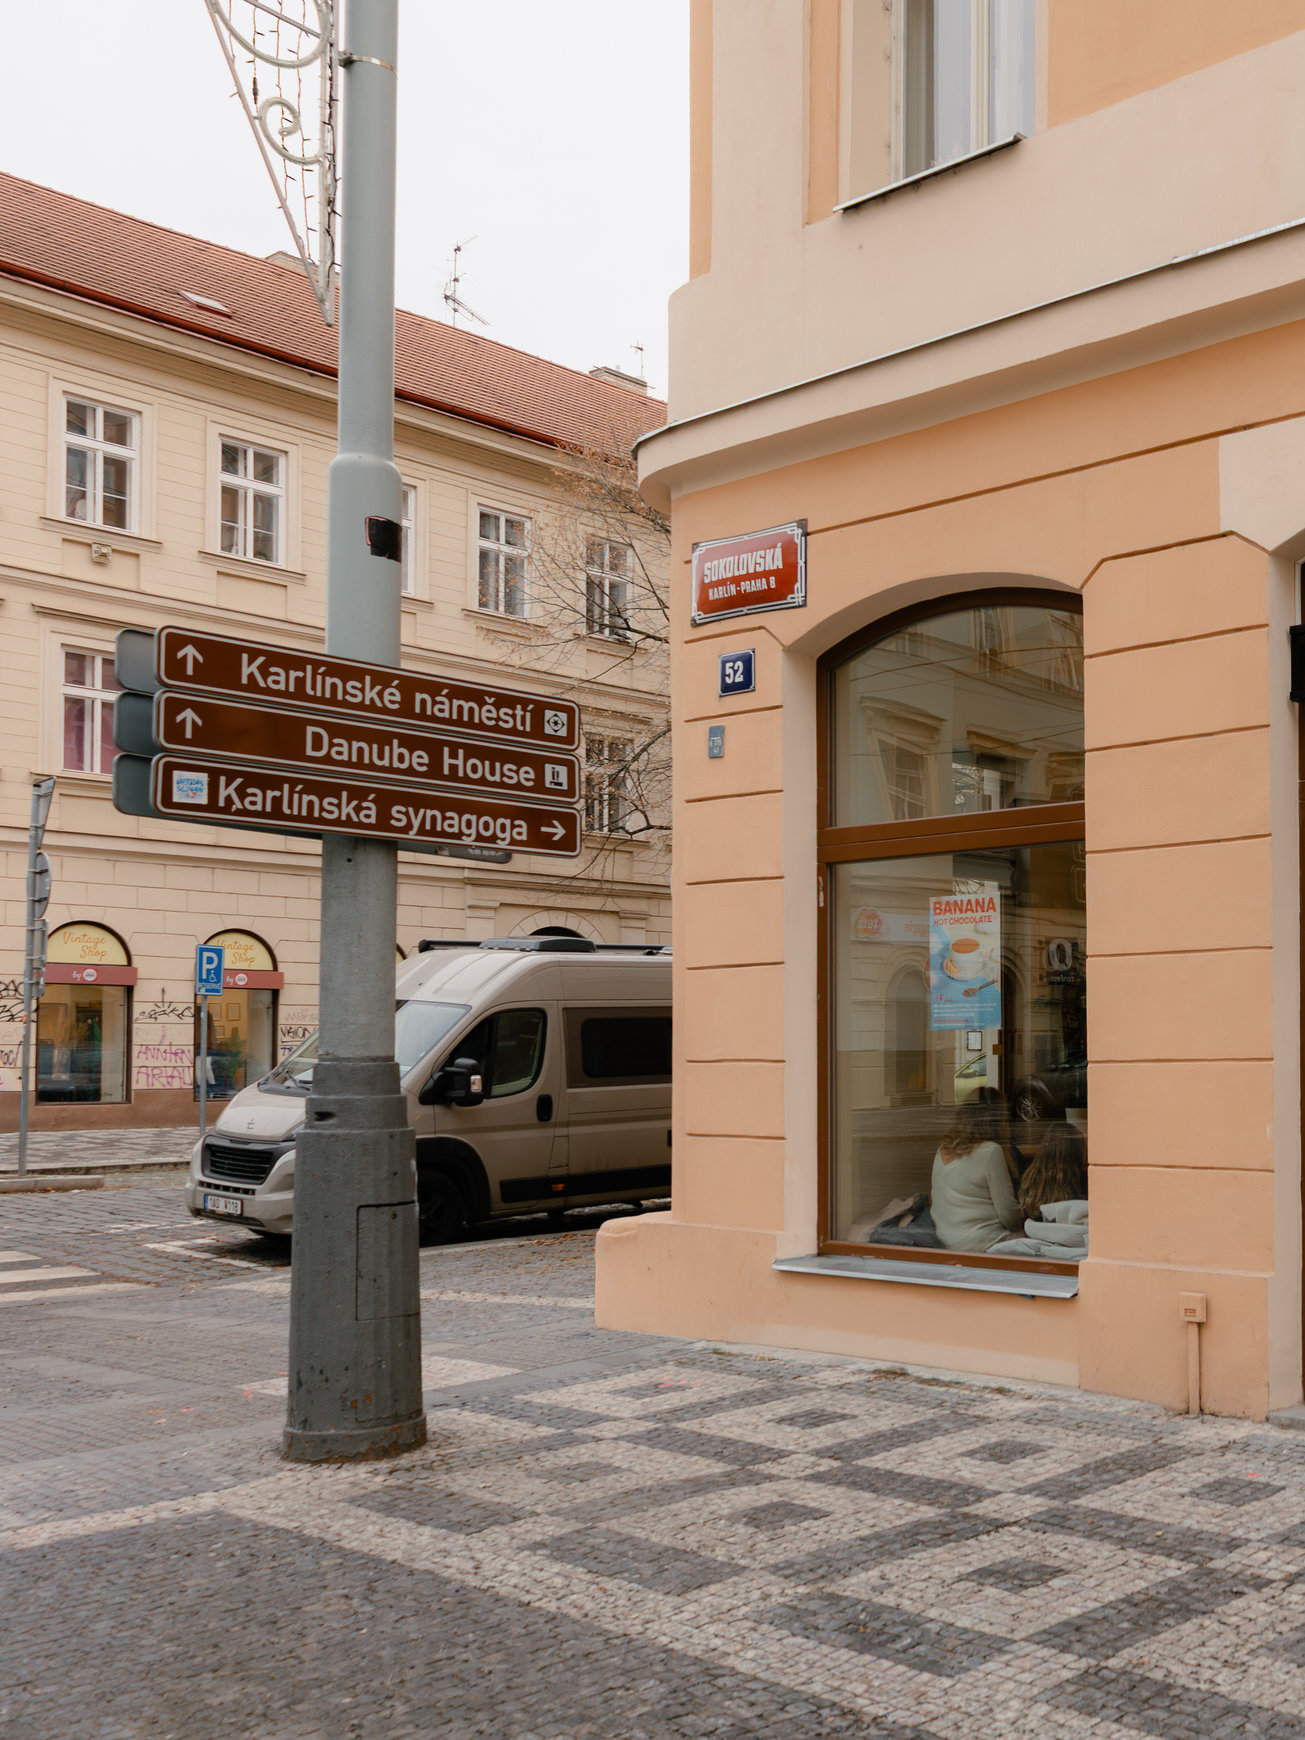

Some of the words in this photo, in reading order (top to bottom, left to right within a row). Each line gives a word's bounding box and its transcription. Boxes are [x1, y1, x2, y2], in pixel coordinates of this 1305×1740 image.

[703, 542, 783, 584] SOKOLOVSKÁ
[768, 576, 776, 589] 8
[724, 661, 744, 684] 52
[240, 653, 401, 710] Karlínské
[414, 688, 535, 733] náměstí
[305, 725, 430, 772] Danube
[442, 746, 536, 787] House
[218, 775, 377, 824] Karlínská
[389, 804, 528, 846] synagoga
[932, 896, 997, 917] BANANA
[933, 917, 948, 926] HOT
[948, 914, 993, 925] CHOCOLATE
[63, 931, 107, 950] Vintage
[80, 944, 107, 961] Shop
[231, 950, 255, 968] Shop
